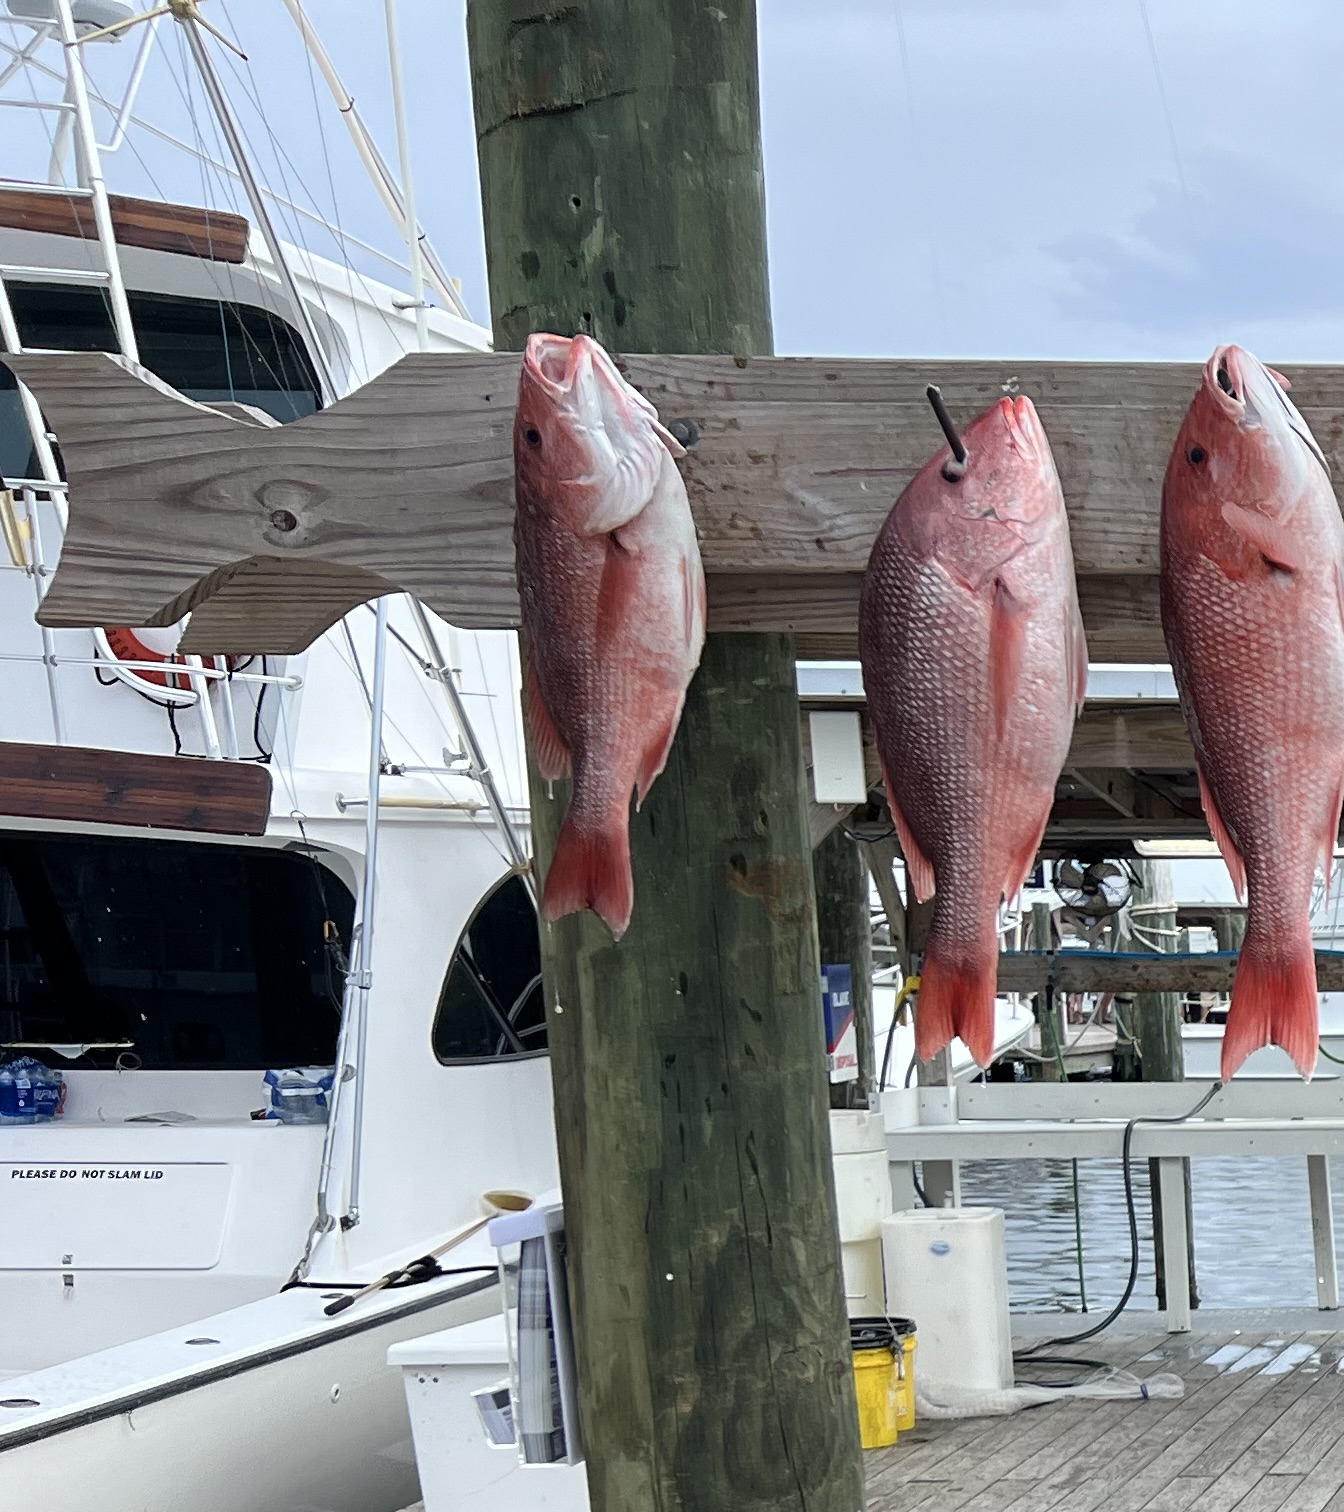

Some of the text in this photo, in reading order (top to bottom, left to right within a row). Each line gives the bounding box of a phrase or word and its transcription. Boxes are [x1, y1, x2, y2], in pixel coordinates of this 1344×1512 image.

[11, 1169, 164, 1180] PLEASE DO NOT SLAM LID
